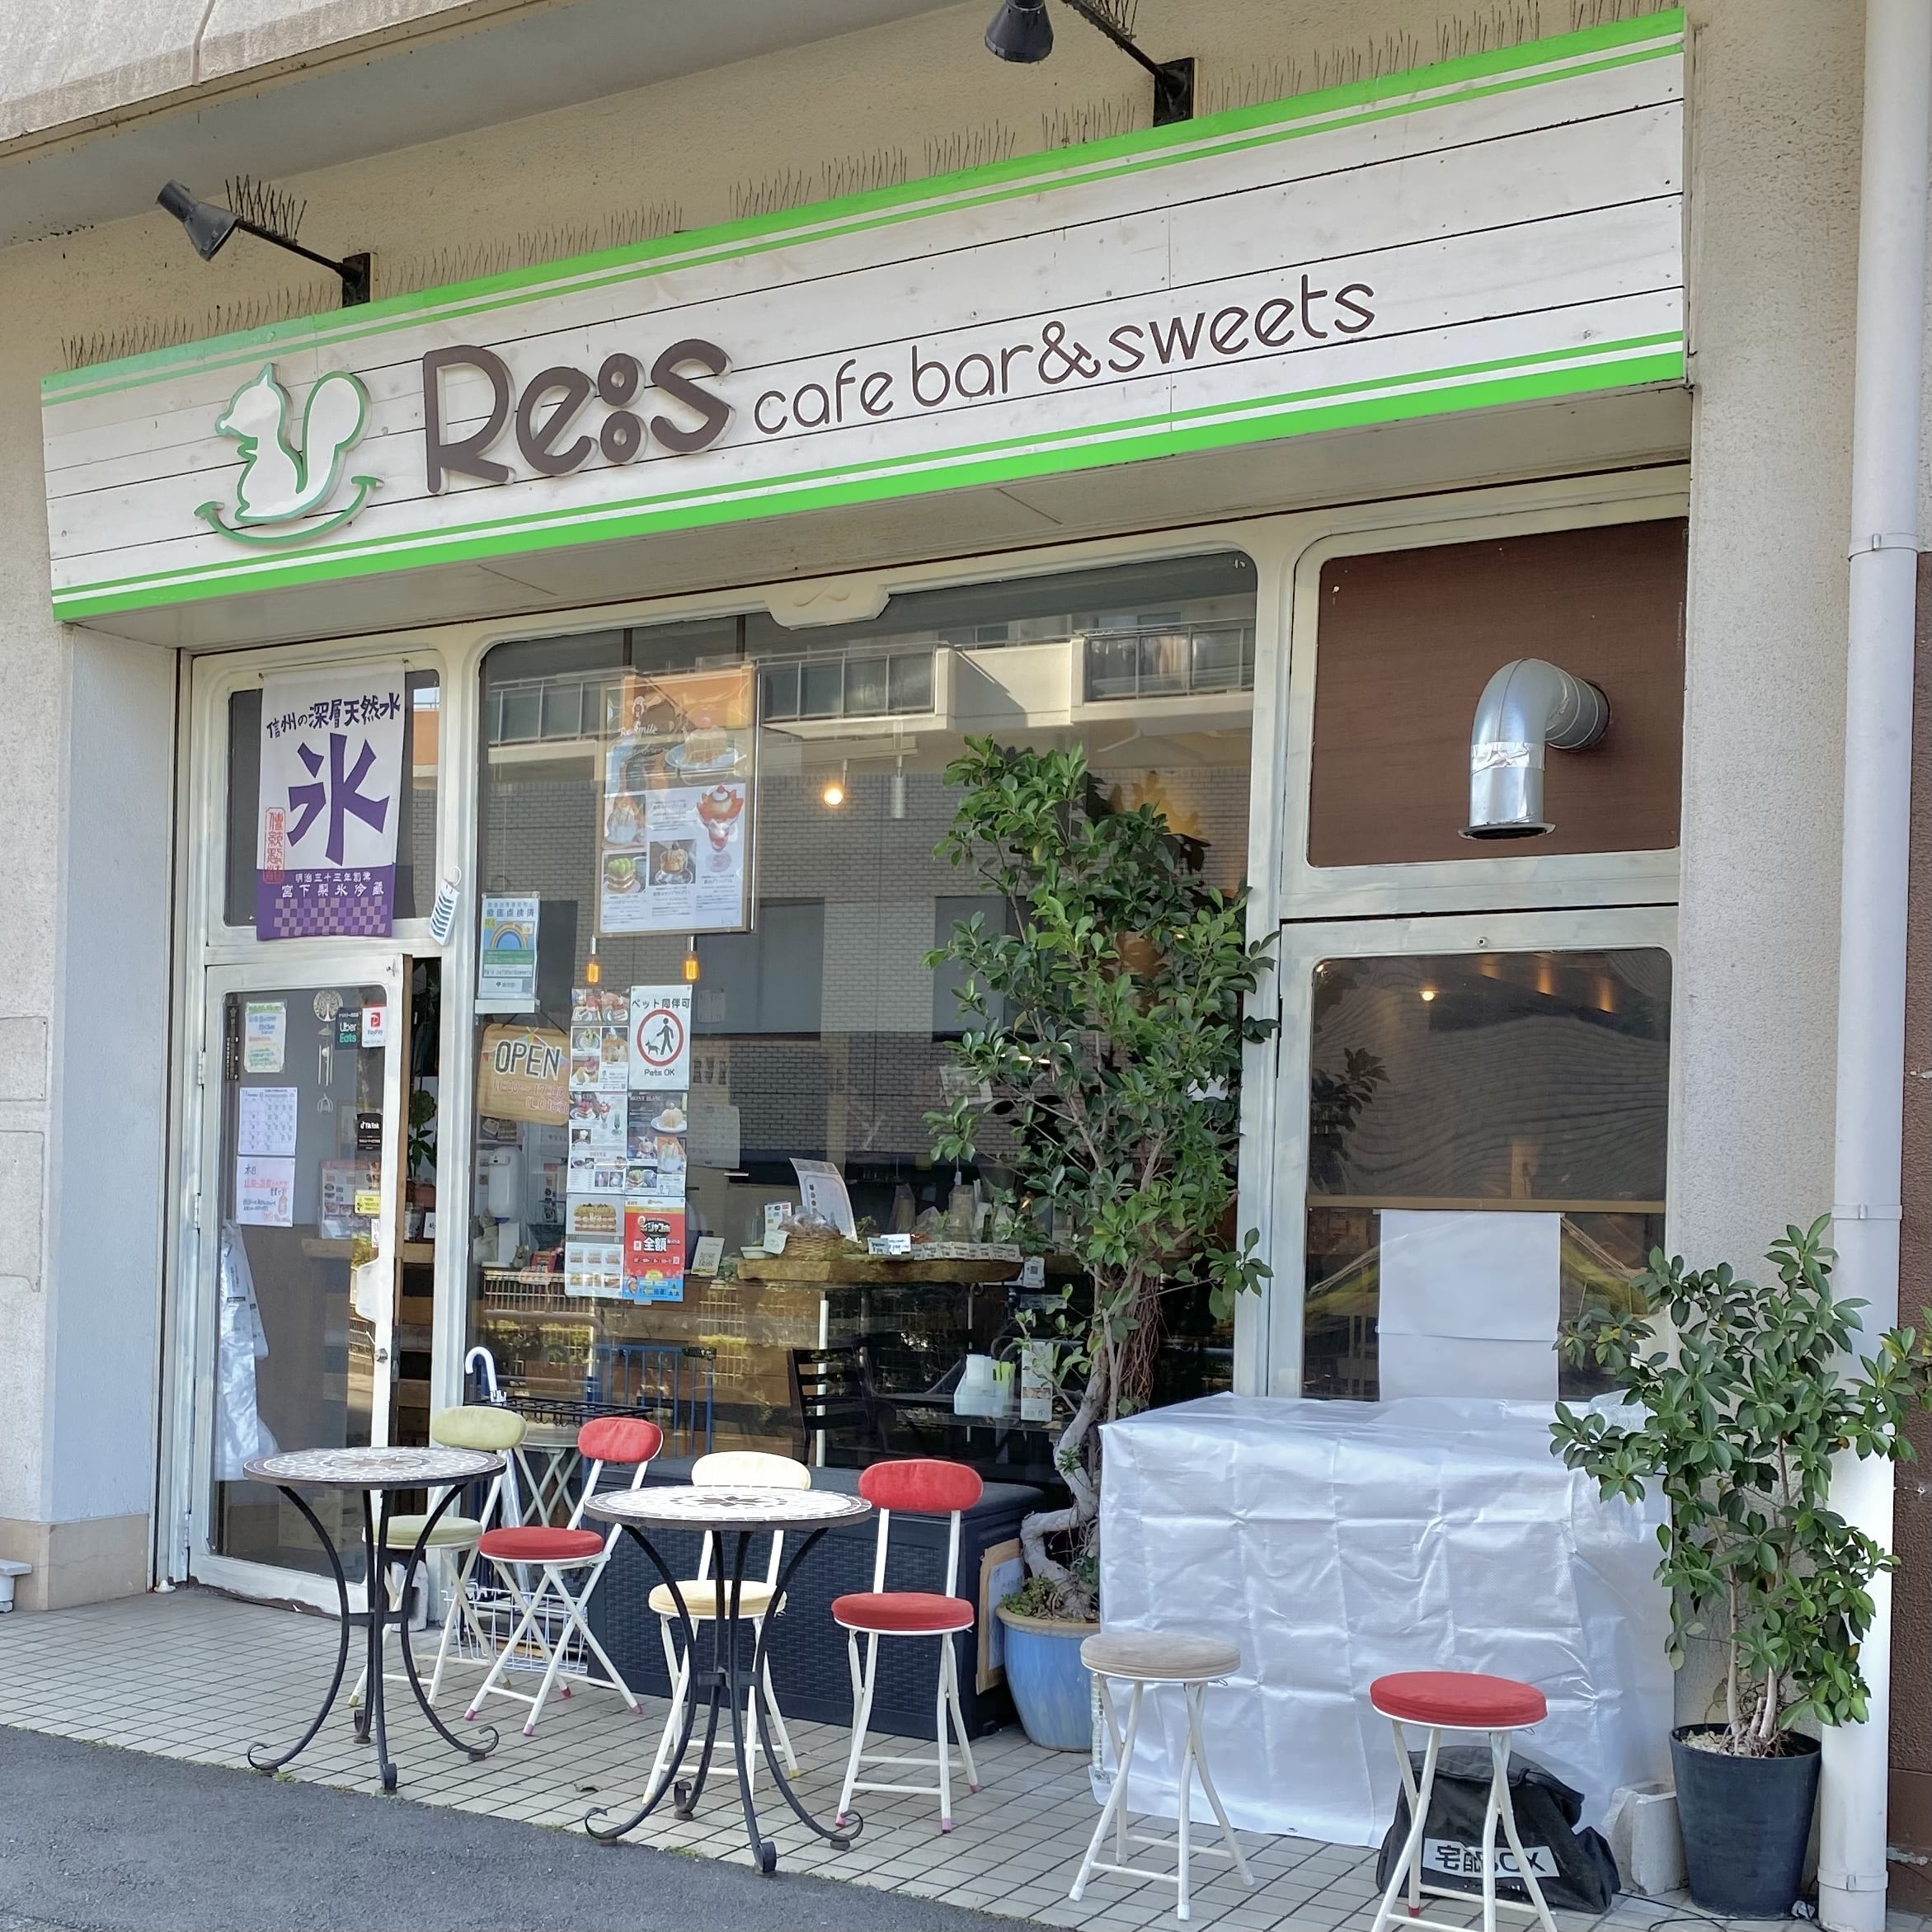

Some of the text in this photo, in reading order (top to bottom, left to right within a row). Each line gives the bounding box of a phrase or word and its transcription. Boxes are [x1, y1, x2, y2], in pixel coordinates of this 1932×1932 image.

[754, 358, 895, 435] cafe
[266, 692, 401, 739] 信州の深層天然水
[286, 732, 391, 867] 氷
[295, 871, 371, 883] 明治三十三年創業
[632, 998, 690, 1009] ペット同伴可
[339, 1022, 357, 1032] Uber
[339, 1032, 357, 1043] Eats
[494, 1040, 562, 1080] OPEN
[643, 1237, 667, 1252] 全額
[1435, 1845, 1546, 1873] 宅配OX
